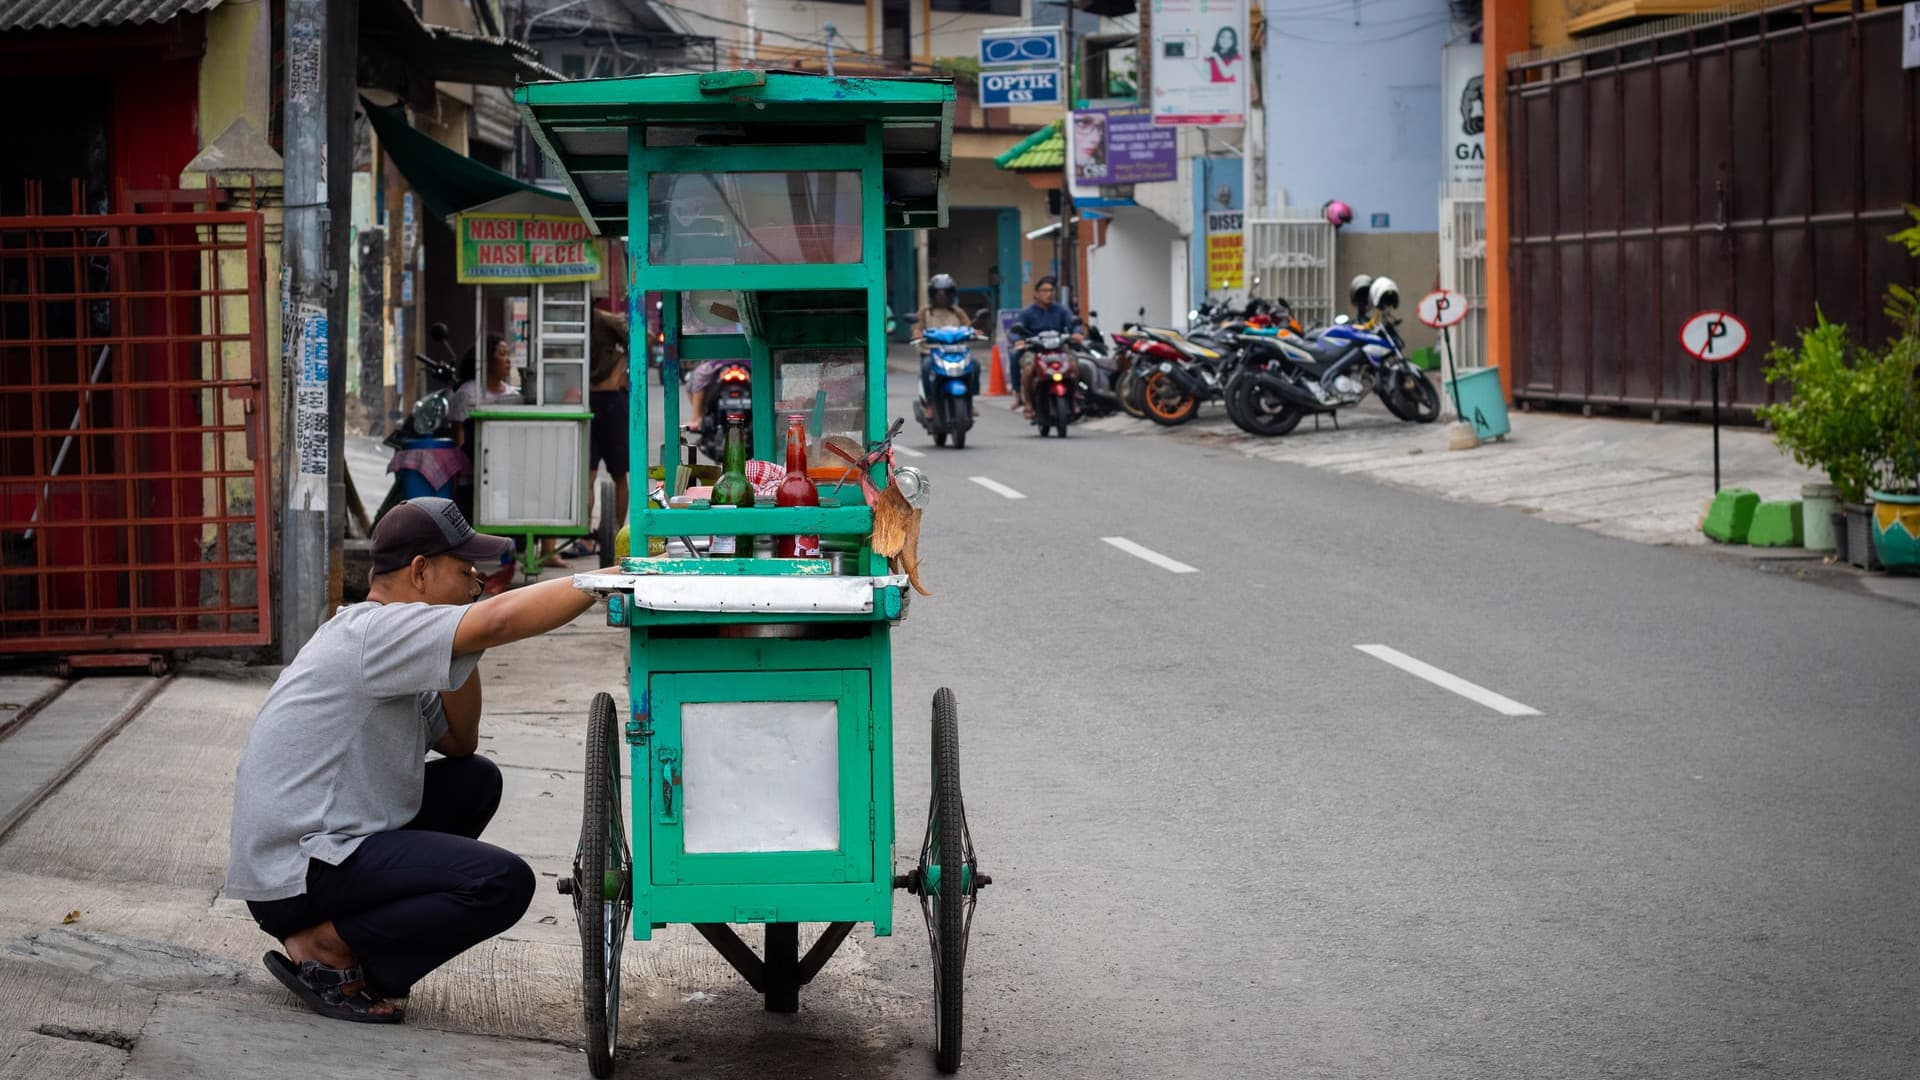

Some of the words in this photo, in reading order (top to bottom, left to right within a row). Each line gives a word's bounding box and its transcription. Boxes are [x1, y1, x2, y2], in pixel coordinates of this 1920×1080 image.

[987, 75, 1053, 90] OPTIK
[1008, 90, 1033, 102] CSS
[470, 221, 516, 240] NASI
[479, 245, 525, 264] NASI
[531, 244, 586, 264] PECEL
[1436, 298, 1450, 322] P
[1707, 321, 1727, 353] P
[304, 342, 313, 381] SEDOT
[297, 391, 308, 406] WC
[301, 435, 311, 474] SEDOT
